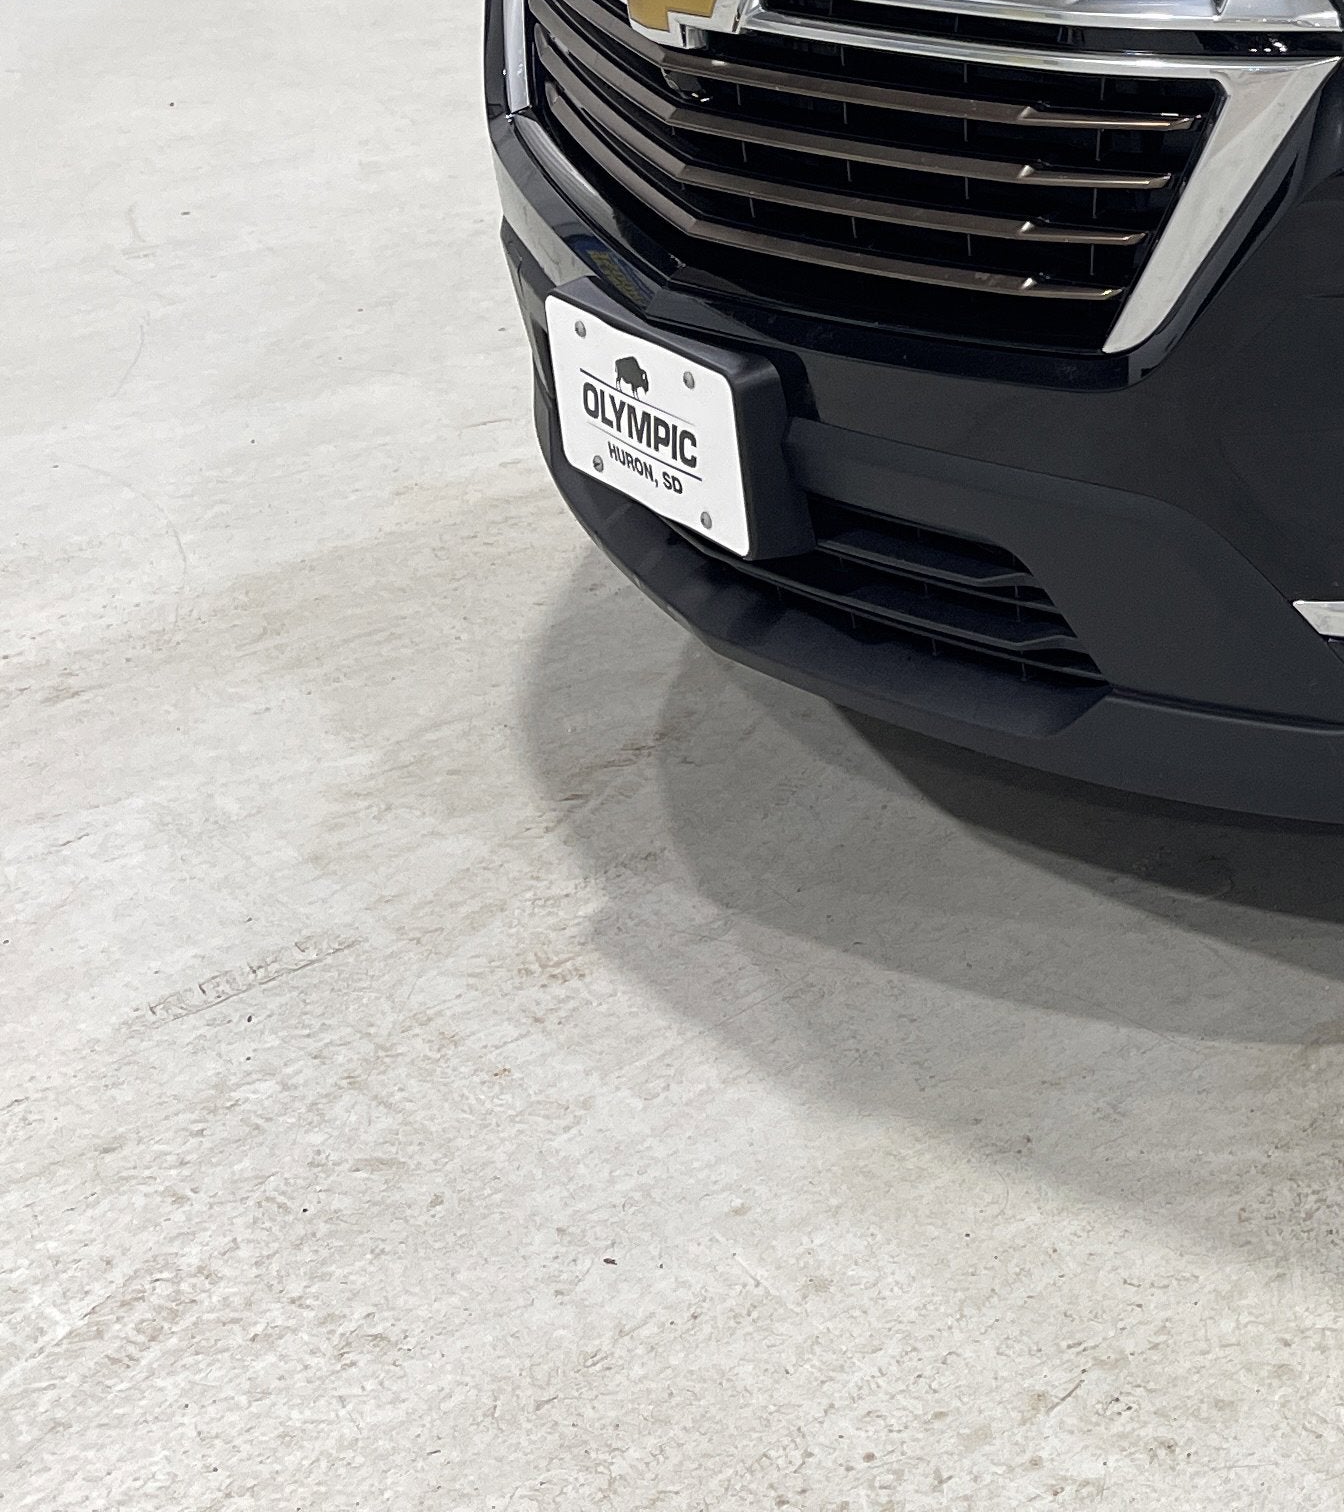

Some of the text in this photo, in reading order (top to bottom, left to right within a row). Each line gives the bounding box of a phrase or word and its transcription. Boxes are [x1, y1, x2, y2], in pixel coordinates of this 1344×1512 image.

[583, 381, 697, 469] OLYMPIC
[608, 440, 683, 494] HURON, SD
